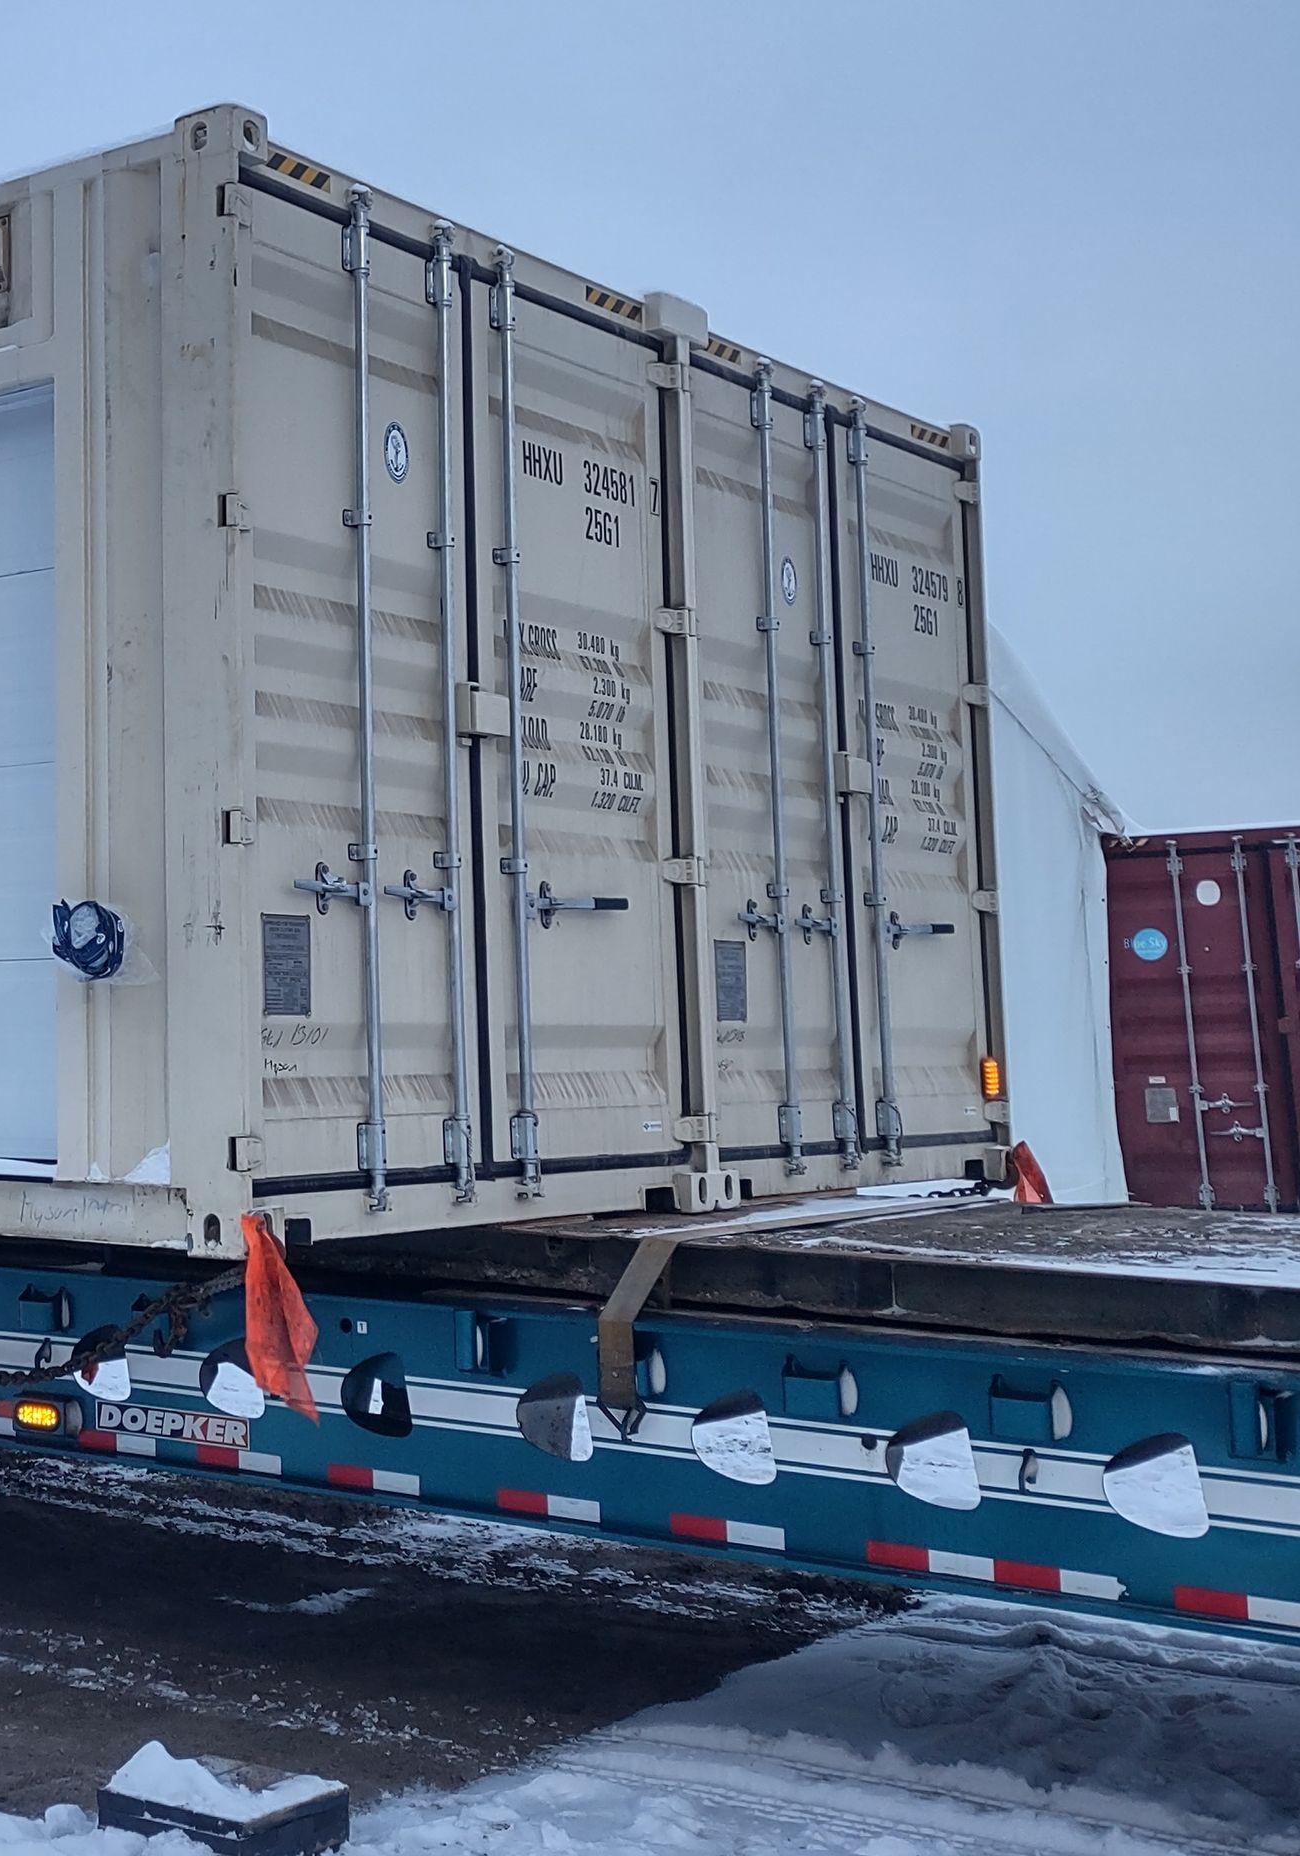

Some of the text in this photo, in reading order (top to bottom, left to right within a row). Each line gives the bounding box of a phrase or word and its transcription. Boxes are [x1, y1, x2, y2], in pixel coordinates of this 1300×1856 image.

[522, 440, 658, 513] HHXU 324581 7
[585, 506, 620, 548] 25G1
[870, 552, 899, 588] HHXU
[911, 565, 949, 602] 324579
[913, 604, 938, 637] 25G1
[610, 640, 620, 662] kg
[520, 666, 631, 705] ARE 2.300 kg
[613, 728, 622, 750] kg
[600, 767, 619, 788] 37.4
[590, 790, 617, 810] 1.320
[99, 1403, 247, 1447] DOEPKER
